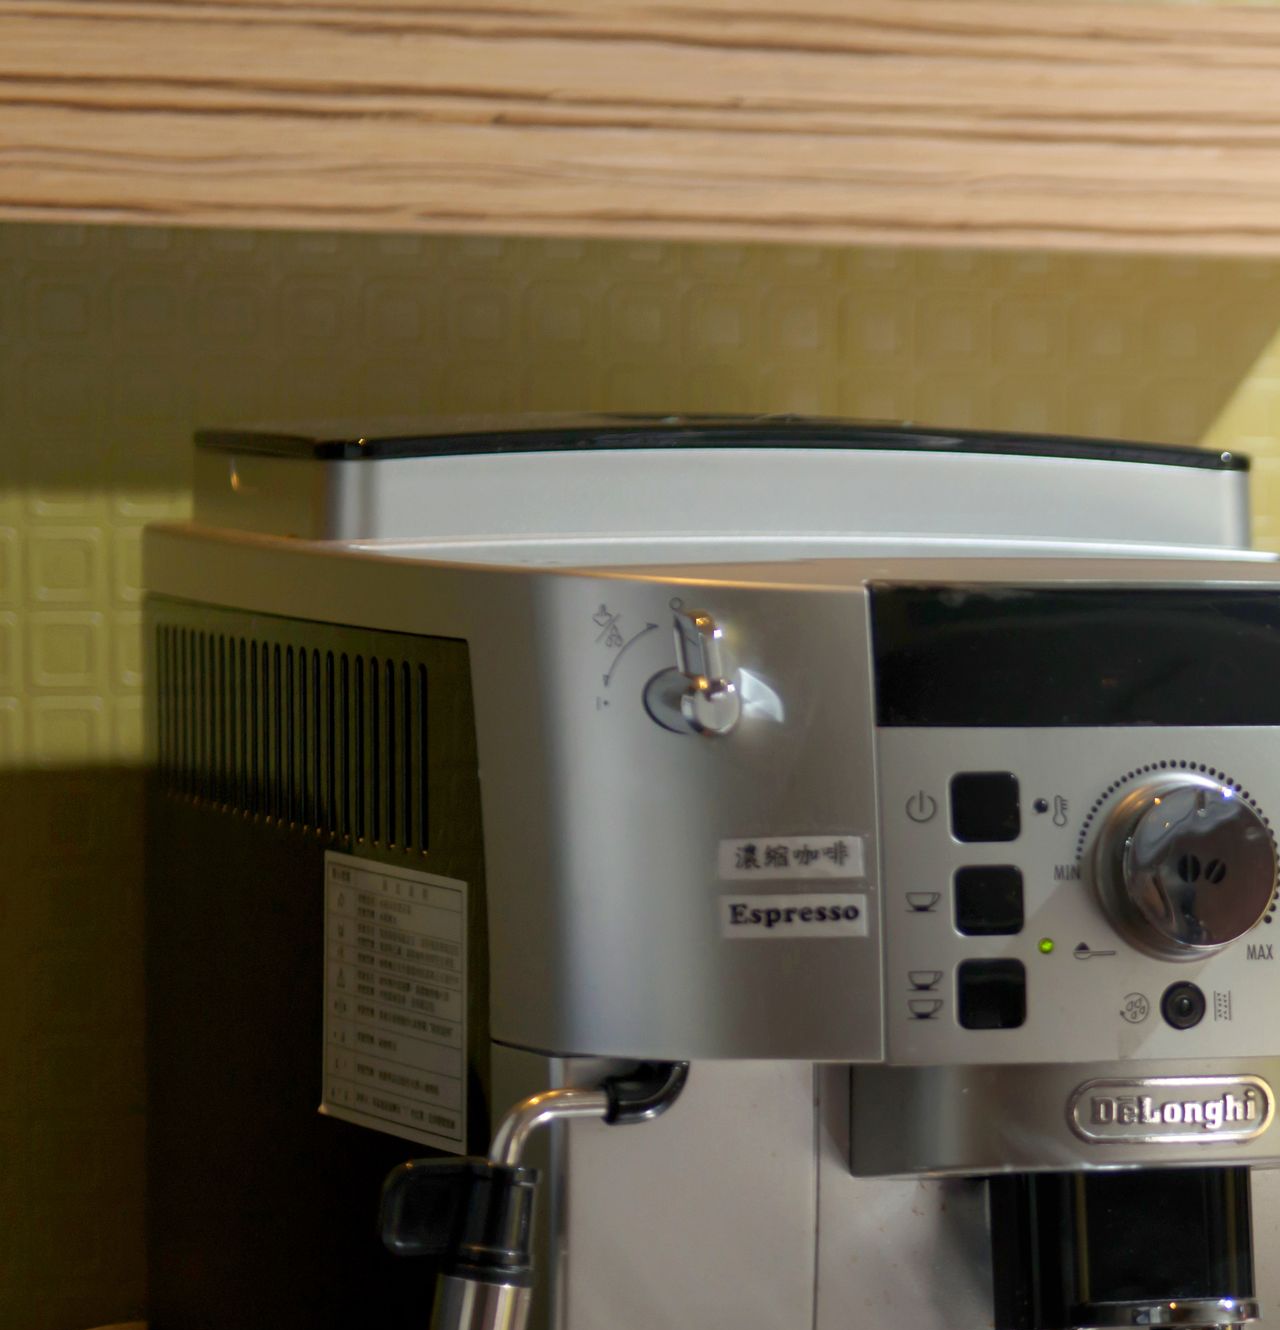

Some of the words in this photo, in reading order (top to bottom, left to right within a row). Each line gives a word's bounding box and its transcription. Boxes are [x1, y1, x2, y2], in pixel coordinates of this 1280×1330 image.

[735, 840, 849, 869] 濃縮咖啡
[1053, 864, 1081, 881] MIN
[728, 903, 860, 928] Espresso
[1246, 943, 1274, 961] MAX
